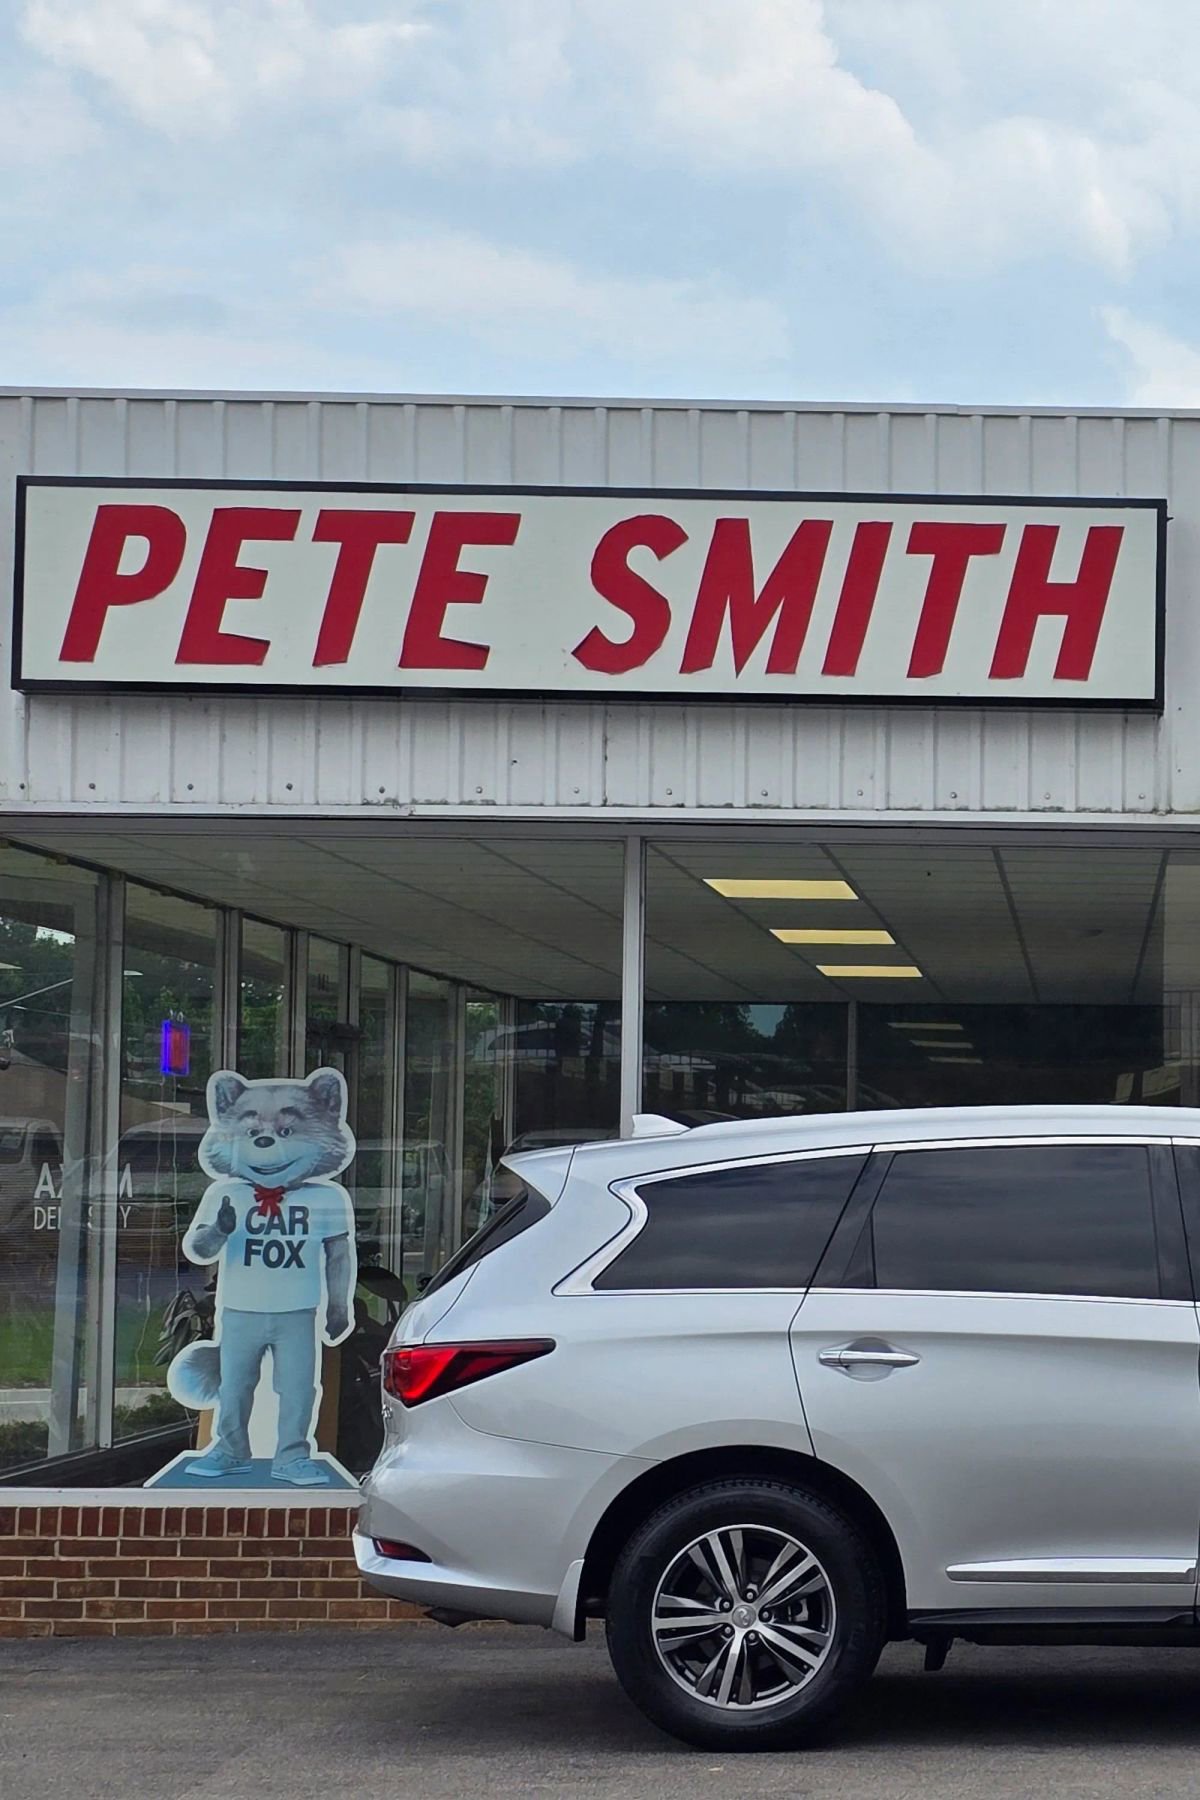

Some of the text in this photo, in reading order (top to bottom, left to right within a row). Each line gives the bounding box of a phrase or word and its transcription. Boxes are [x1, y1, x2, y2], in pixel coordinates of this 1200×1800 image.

[59, 504, 1125, 681] PETE SMITH
[245, 1205, 309, 1235] CAR
[244, 1239, 306, 1268] FOX
